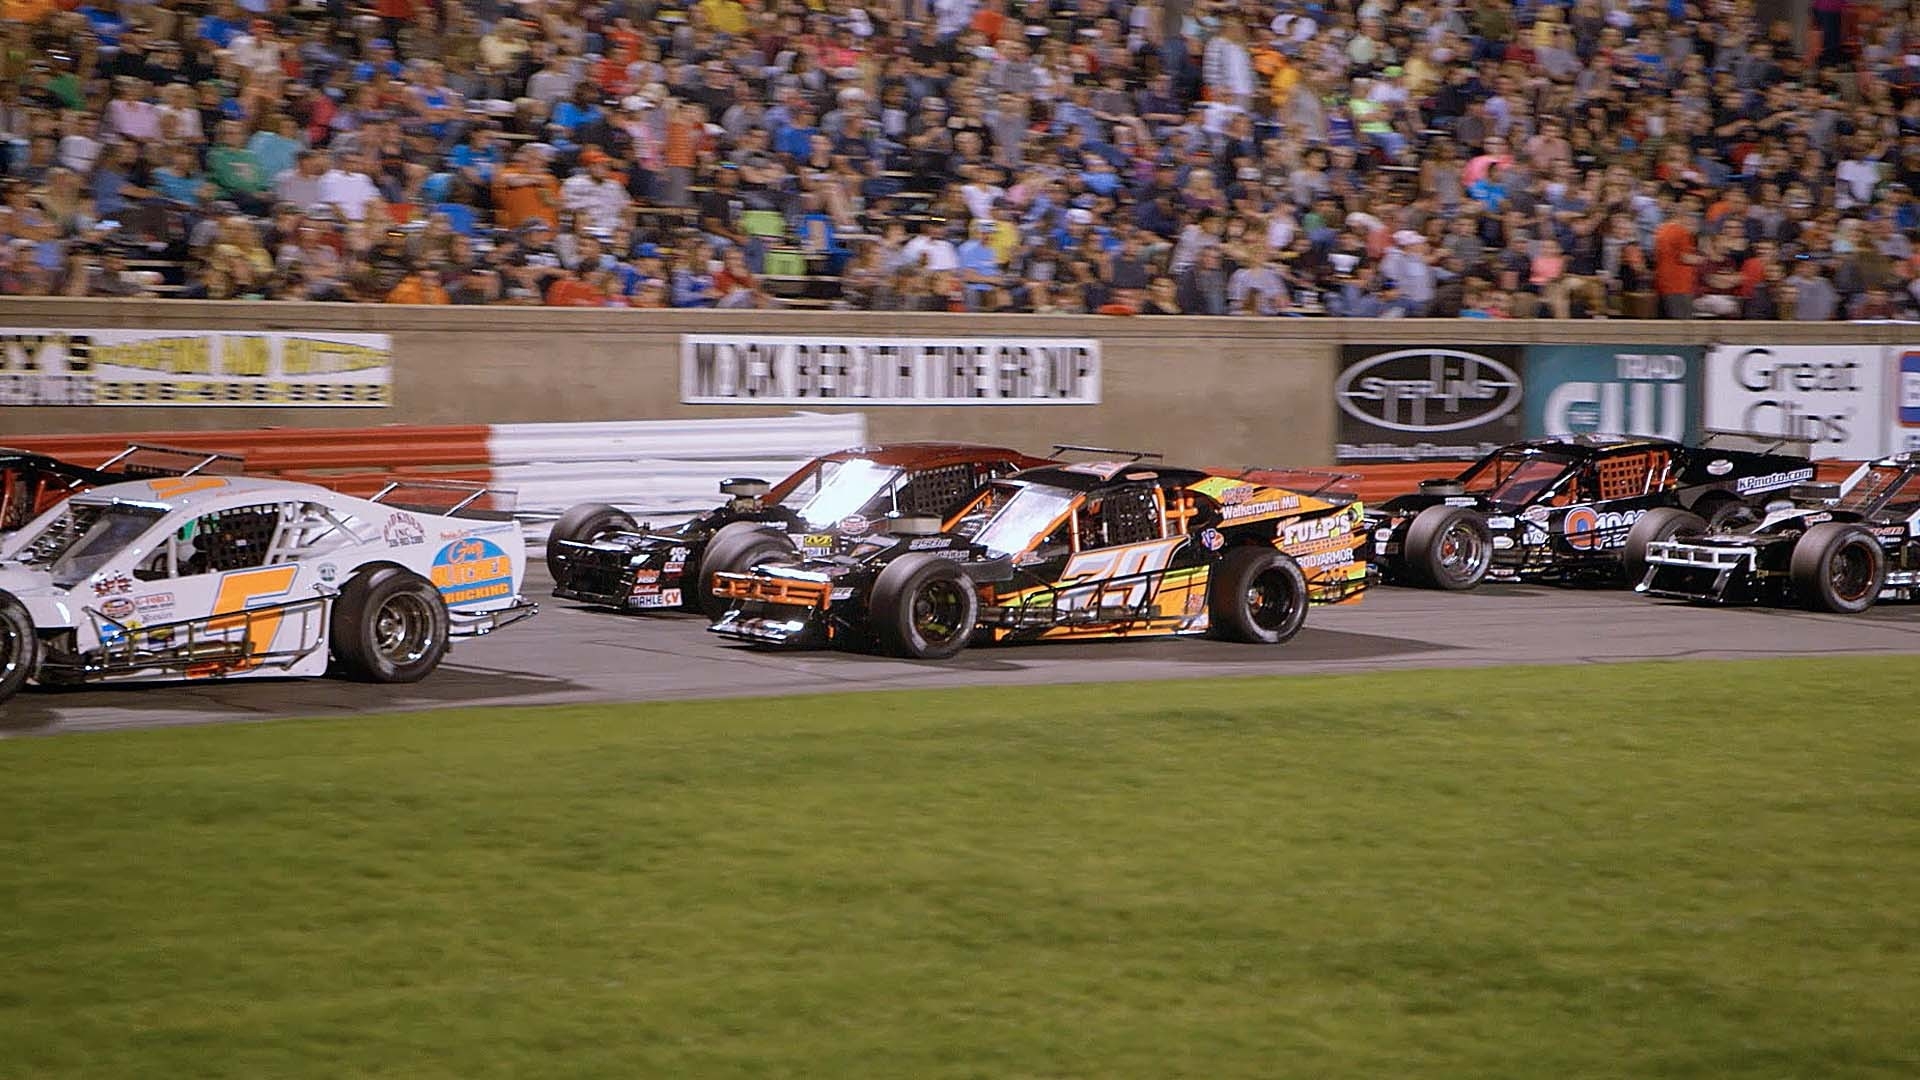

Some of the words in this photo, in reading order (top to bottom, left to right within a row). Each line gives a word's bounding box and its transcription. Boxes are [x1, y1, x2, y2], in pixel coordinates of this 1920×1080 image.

[1733, 348, 1860, 393] Great
[1743, 400, 1852, 443] Clips
[1737, 468, 1814, 492] KPmoto.com
[1222, 500, 1280, 520] Walkertown
[1281, 494, 1300, 509] Mill
[1283, 515, 1350, 545] FULP'S
[629, 595, 662, 607] MAHLE
